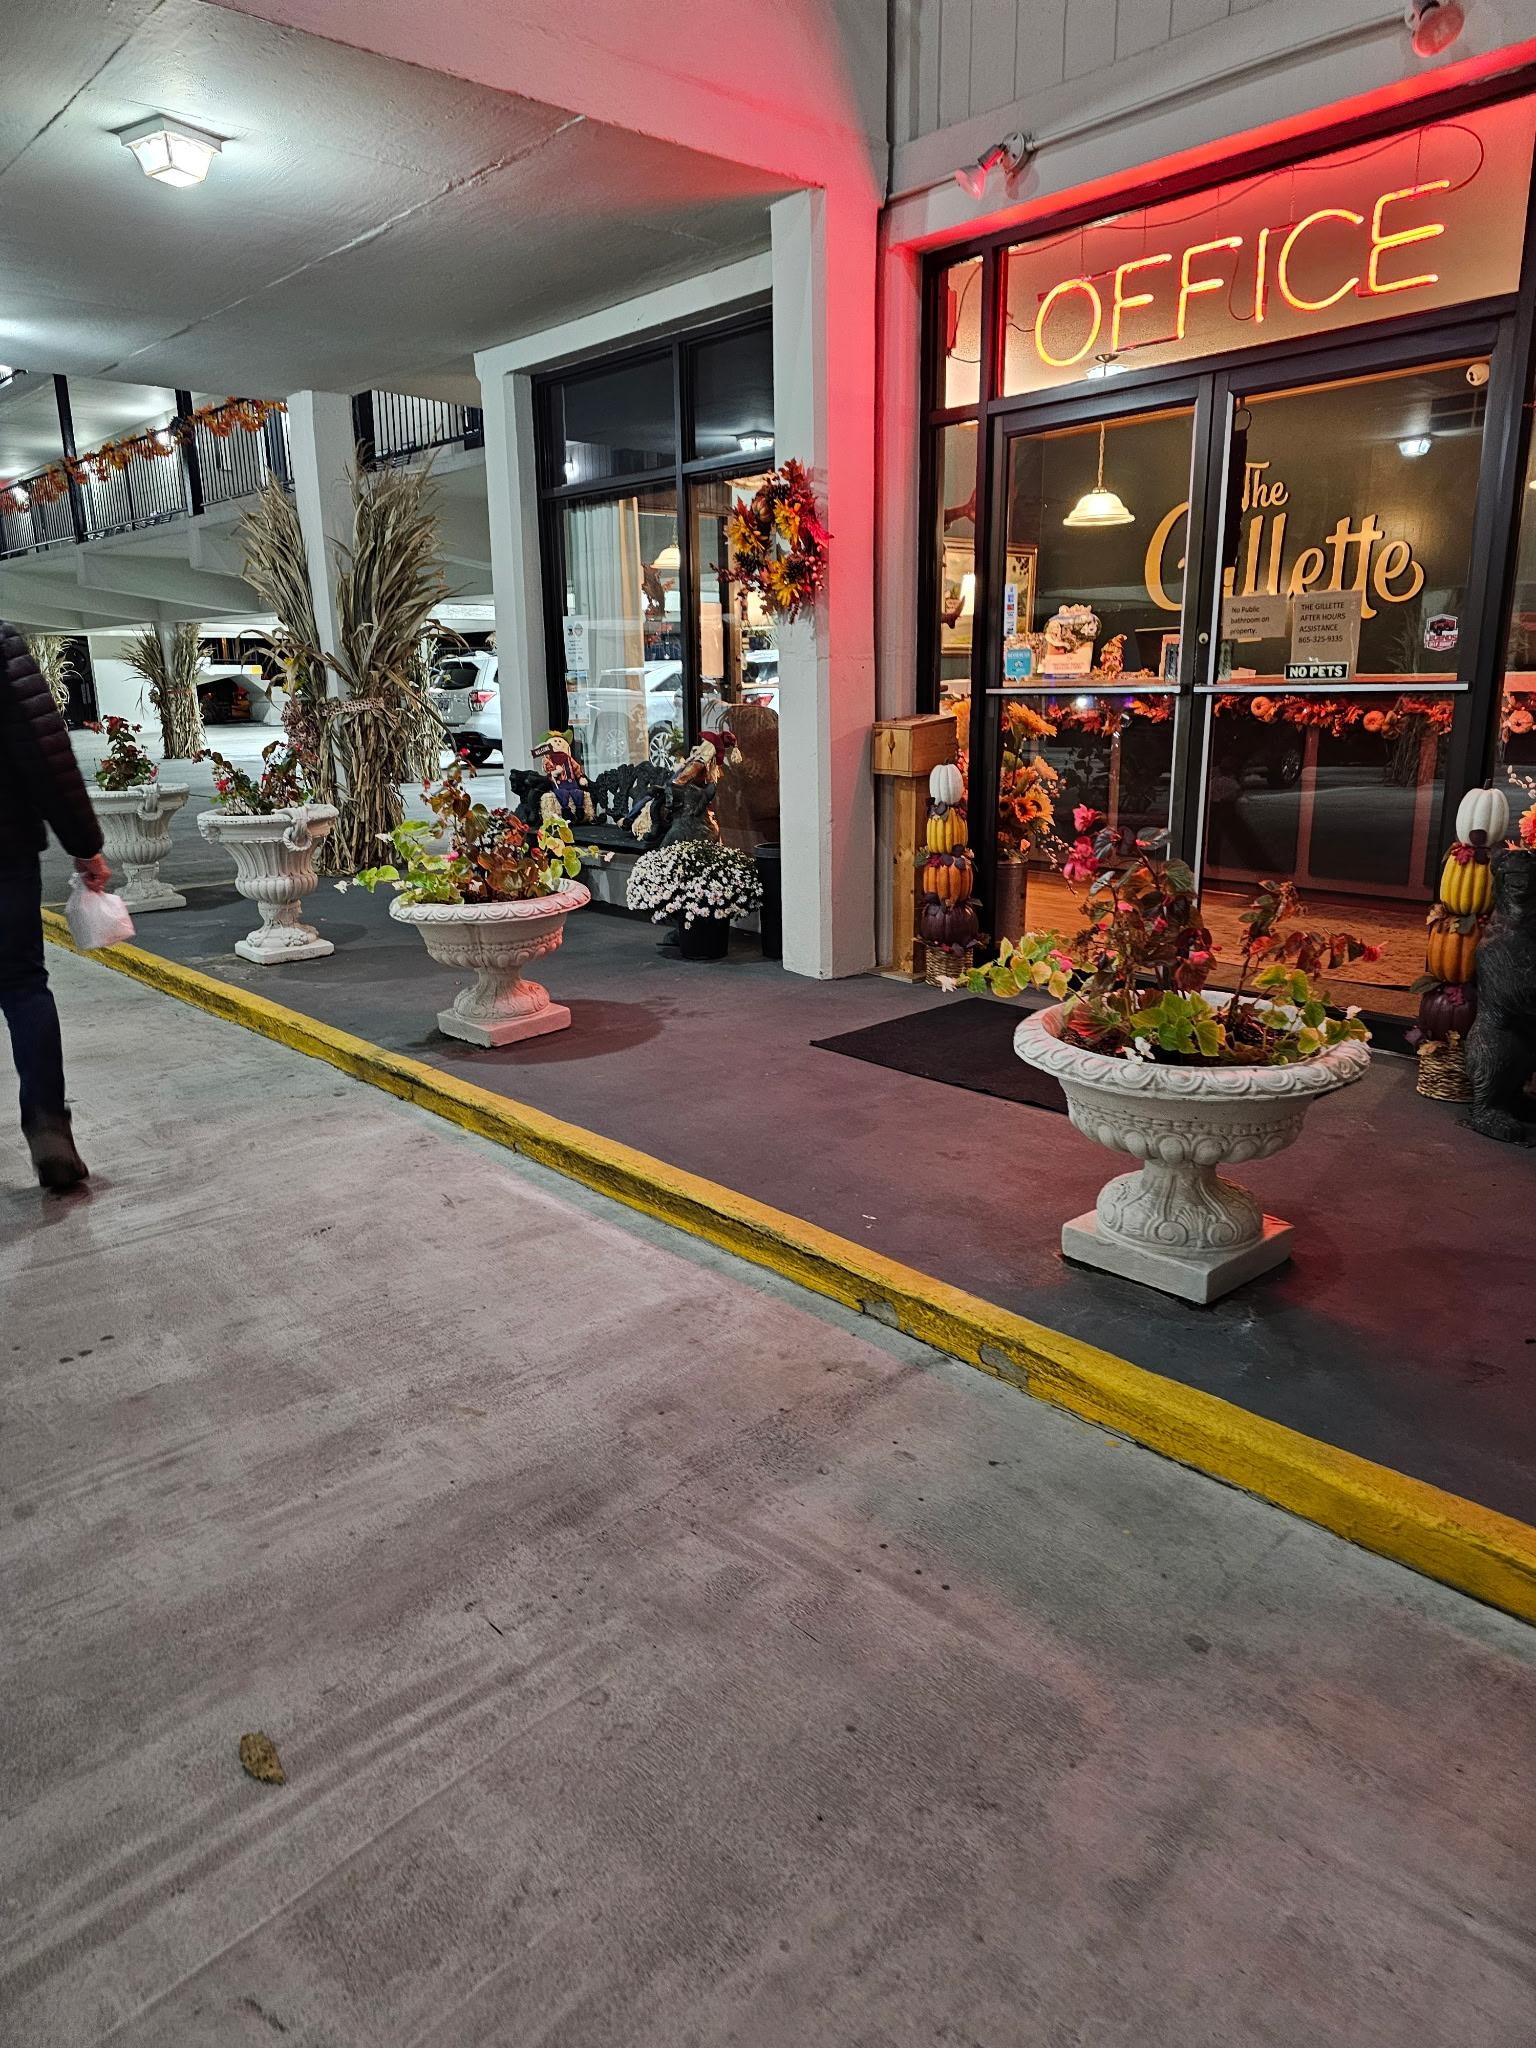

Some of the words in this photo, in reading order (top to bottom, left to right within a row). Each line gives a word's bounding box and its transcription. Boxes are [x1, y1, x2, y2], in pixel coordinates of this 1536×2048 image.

[1034, 178, 1451, 367] OFFICE
[1242, 461, 1288, 512] The
[1301, 603, 1313, 611] THE
[1315, 602, 1344, 610] GILLETTE
[1322, 612, 1346, 621] HOURS
[1299, 624, 1338, 633] ASSISTANCE
[1289, 666, 1308, 678] NO
[1309, 665, 1343, 678] PETS
